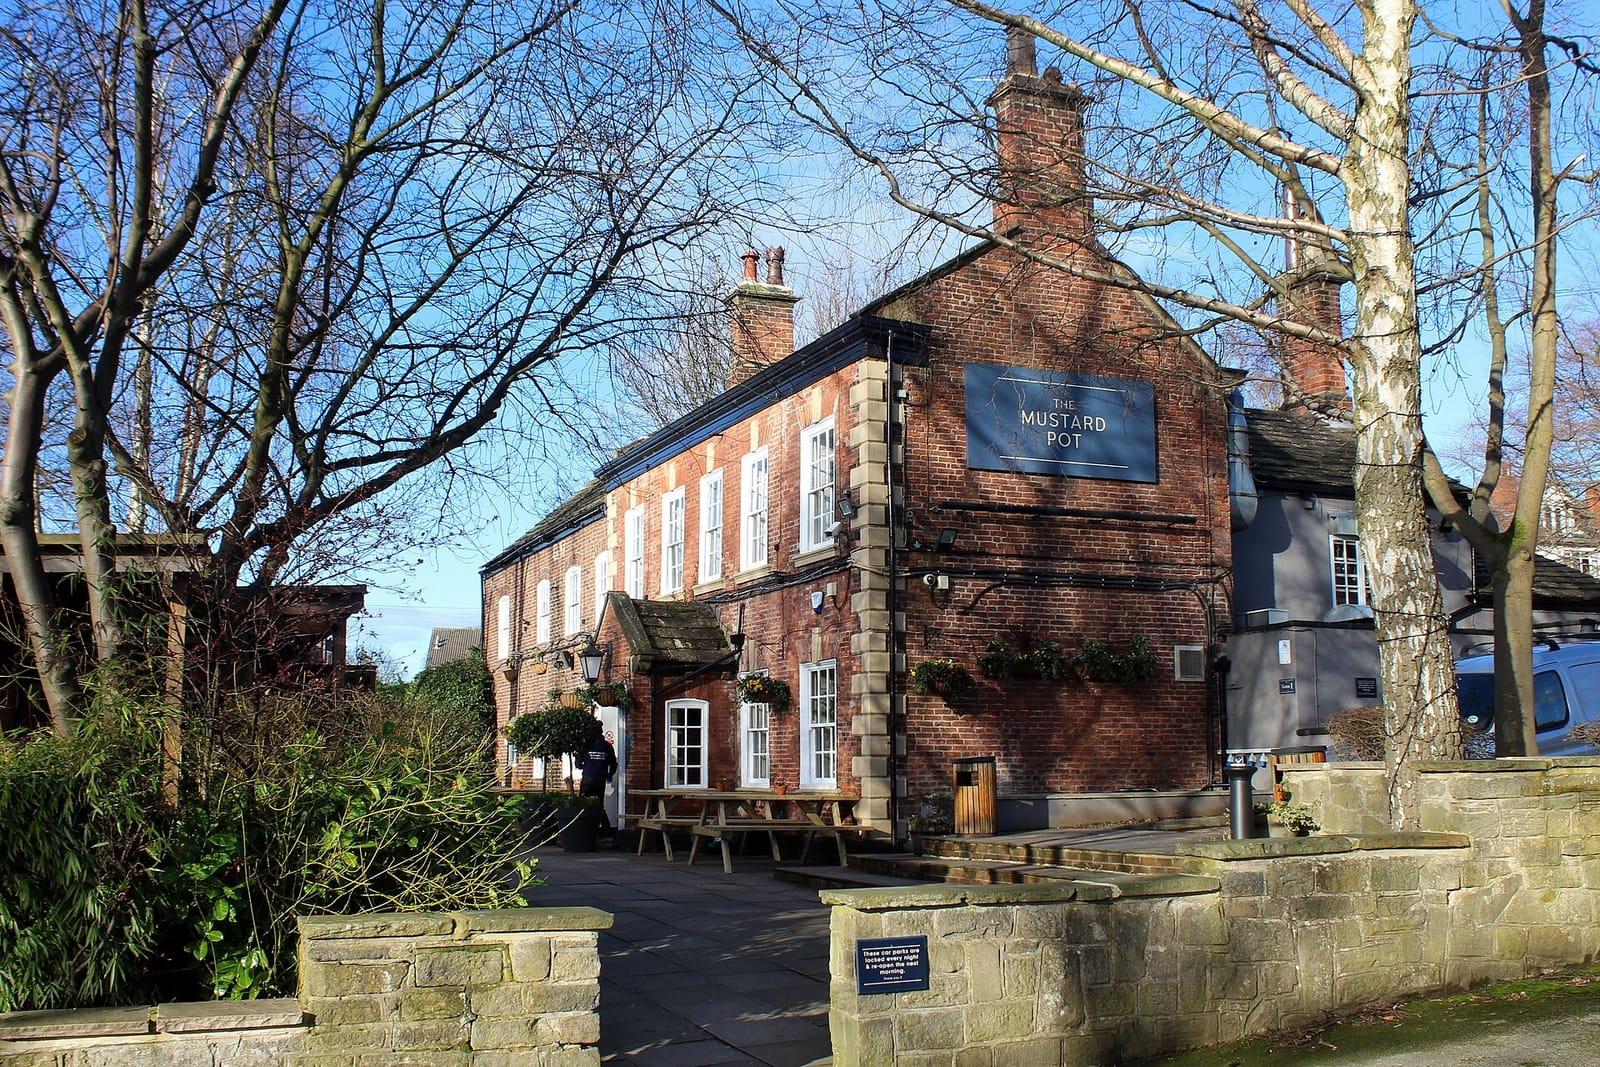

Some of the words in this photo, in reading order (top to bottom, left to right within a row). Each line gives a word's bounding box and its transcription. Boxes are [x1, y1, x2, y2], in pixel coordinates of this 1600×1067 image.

[1053, 398, 1074, 410] THE
[1021, 410, 1106, 432] MUSTARD
[1047, 432, 1082, 449] POT
